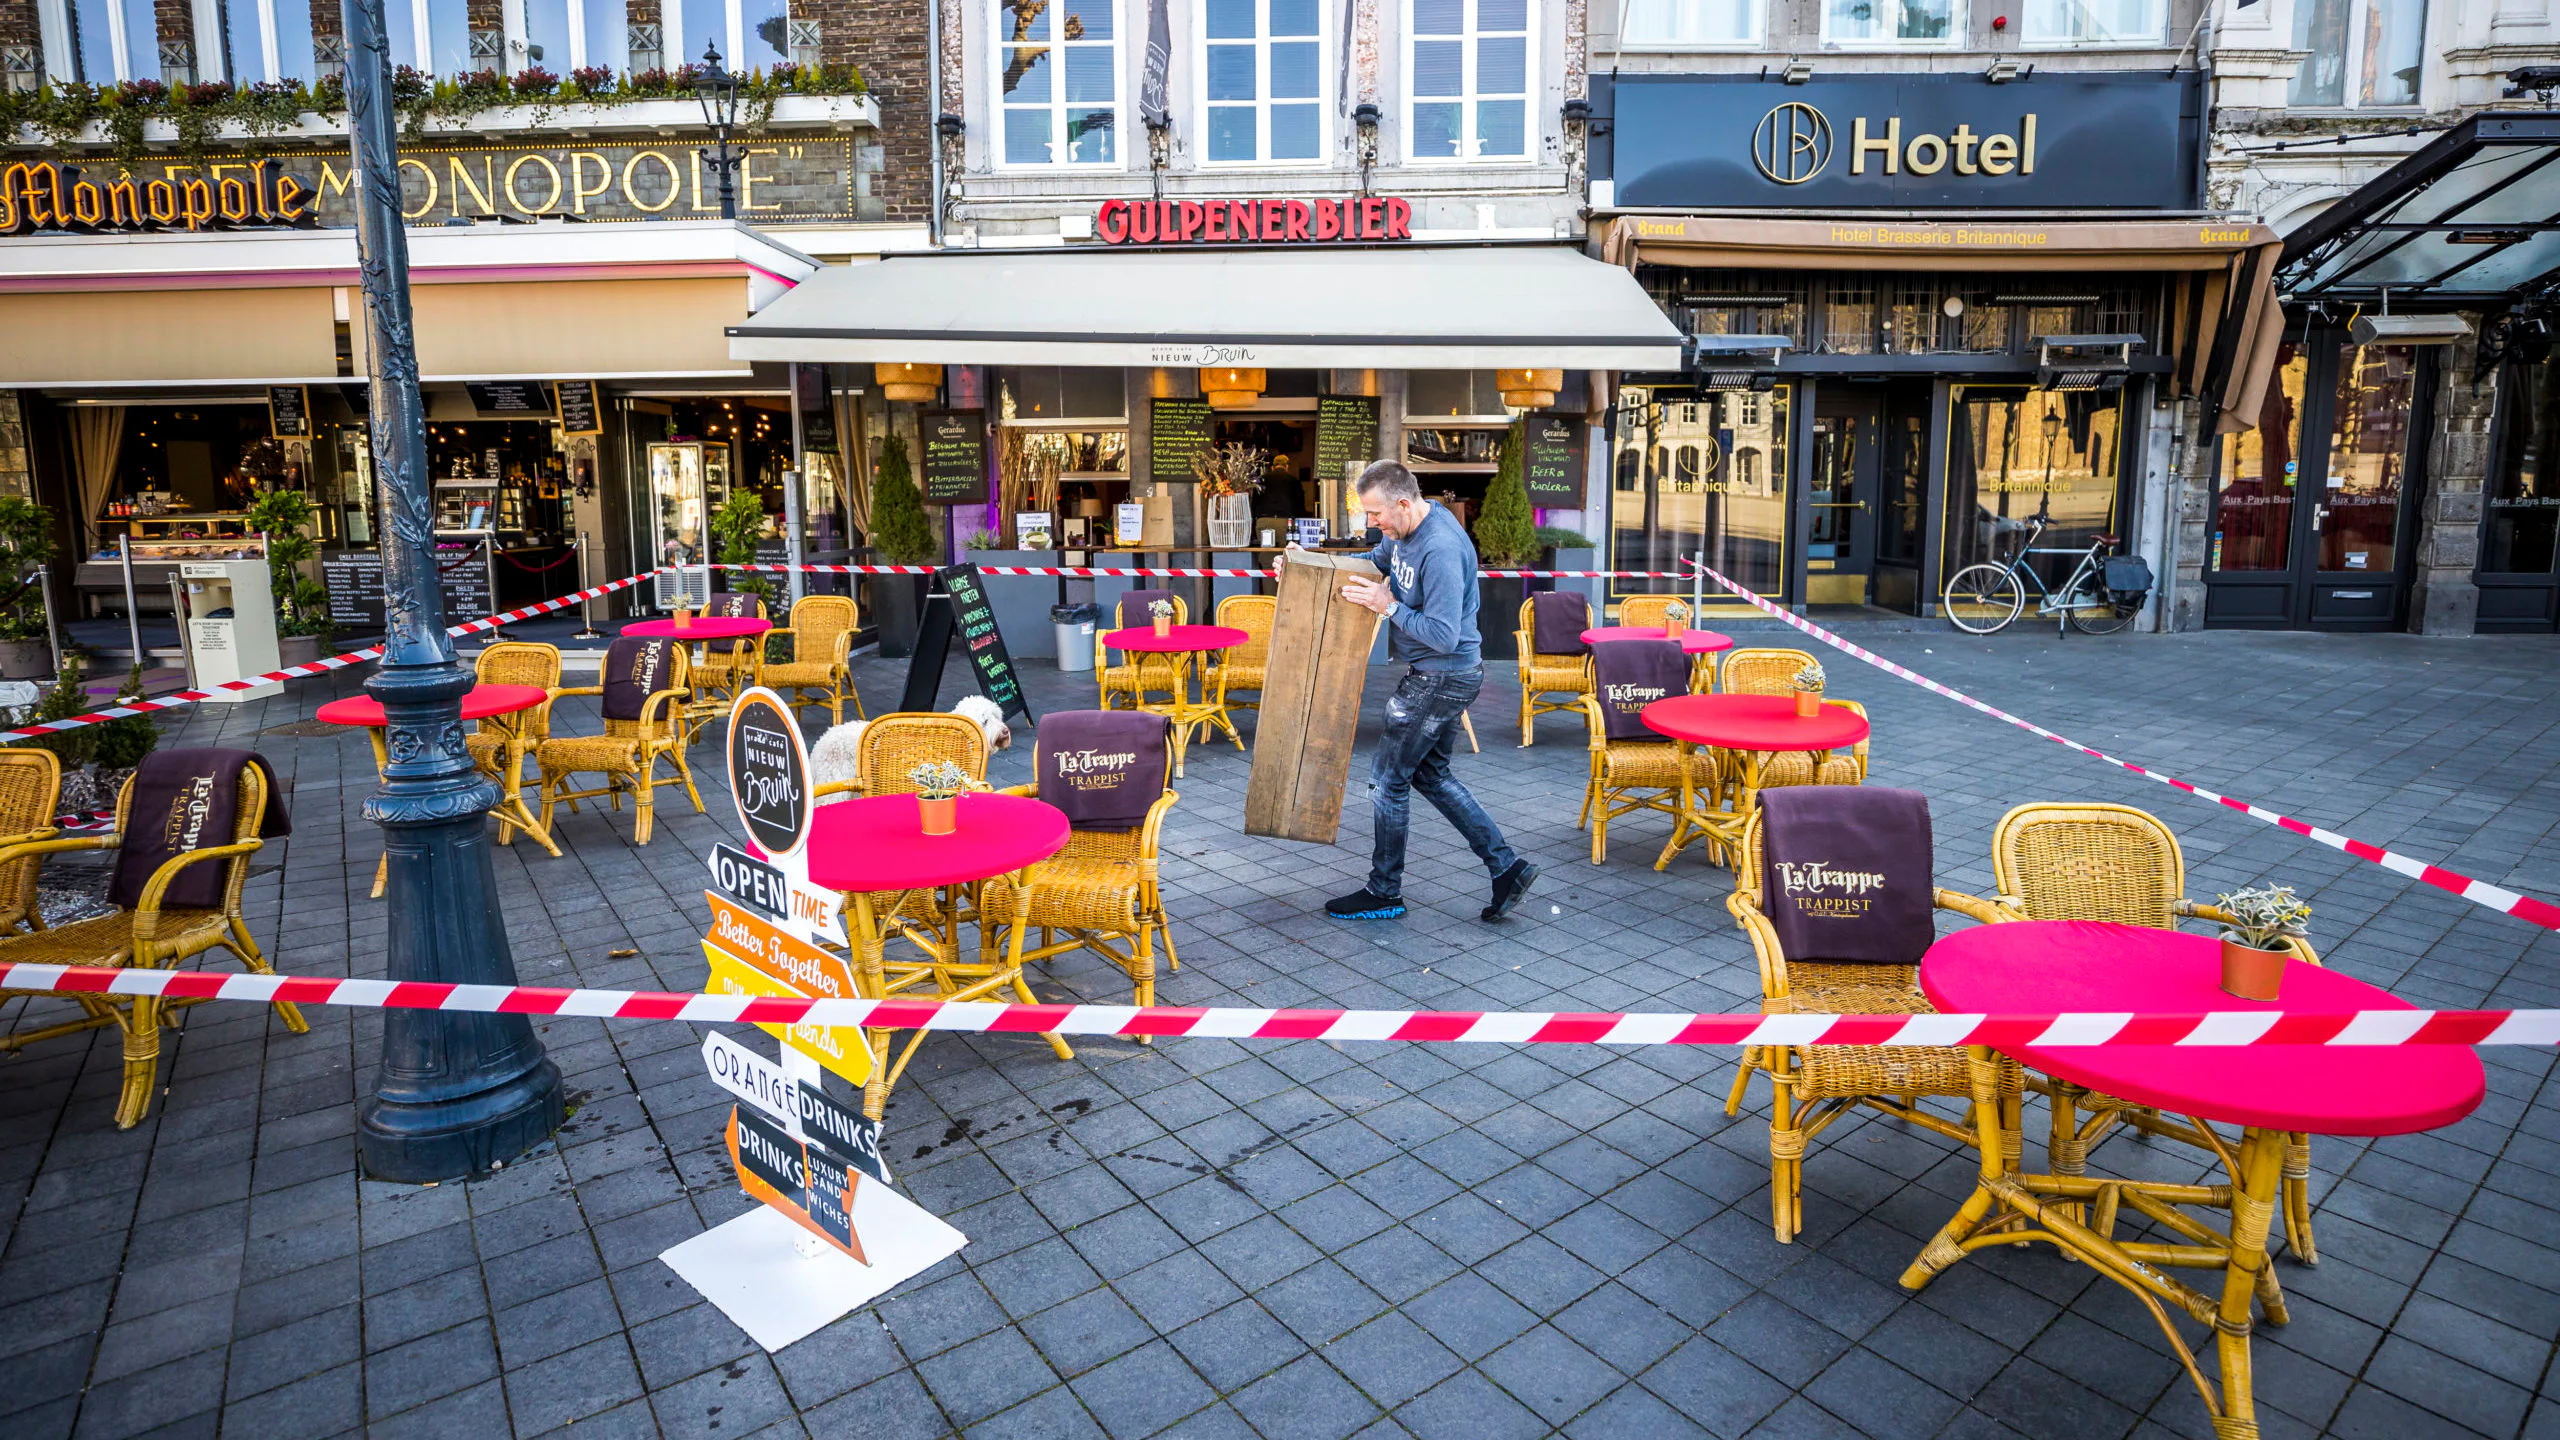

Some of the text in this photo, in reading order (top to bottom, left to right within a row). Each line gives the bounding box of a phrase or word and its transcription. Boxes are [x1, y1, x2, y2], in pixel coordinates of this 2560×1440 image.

[1850, 114, 2037, 176] Hotel
[0, 160, 312, 231] Monopole
[1638, 219, 1685, 236] Brand
[1831, 227, 2046, 247] Hotel Brasserie Britannique
[2200, 228, 2249, 244] Brand
[1152, 354, 1192, 362] NIEUW
[1989, 478, 2071, 494] Britannique
[2223, 495, 2292, 506] Aux Pays Bas
[2329, 495, 2398, 506] Aux Pays Bas
[2491, 497, 2560, 508] Aux Pays Bas
[633, 647, 646, 687] TRAPPIST
[642, 653, 660, 696] Trappe
[1604, 682, 1666, 703] La Trappe
[1616, 702, 1650, 710] TRAPPI
[748, 748, 785, 769] NIEUW
[1053, 749, 1136, 778] La Trappe
[191, 770, 216, 799] La
[1068, 772, 1126, 786] TRAPPIST
[167, 787, 190, 854] TRAPPIST
[720, 856, 828, 928] OPEN TIME
[1775, 860, 1886, 897] La Trappe
[1795, 897, 1872, 911] TRAPPIST
[718, 909, 841, 998] Better Together
[713, 1045, 876, 1159] ORANGE DRINKS
[738, 1120, 805, 1189] DRINKS
[807, 1154, 849, 1188] LUXURY
[813, 1173, 842, 1199] SAND
[808, 1189, 849, 1229] WICHES
